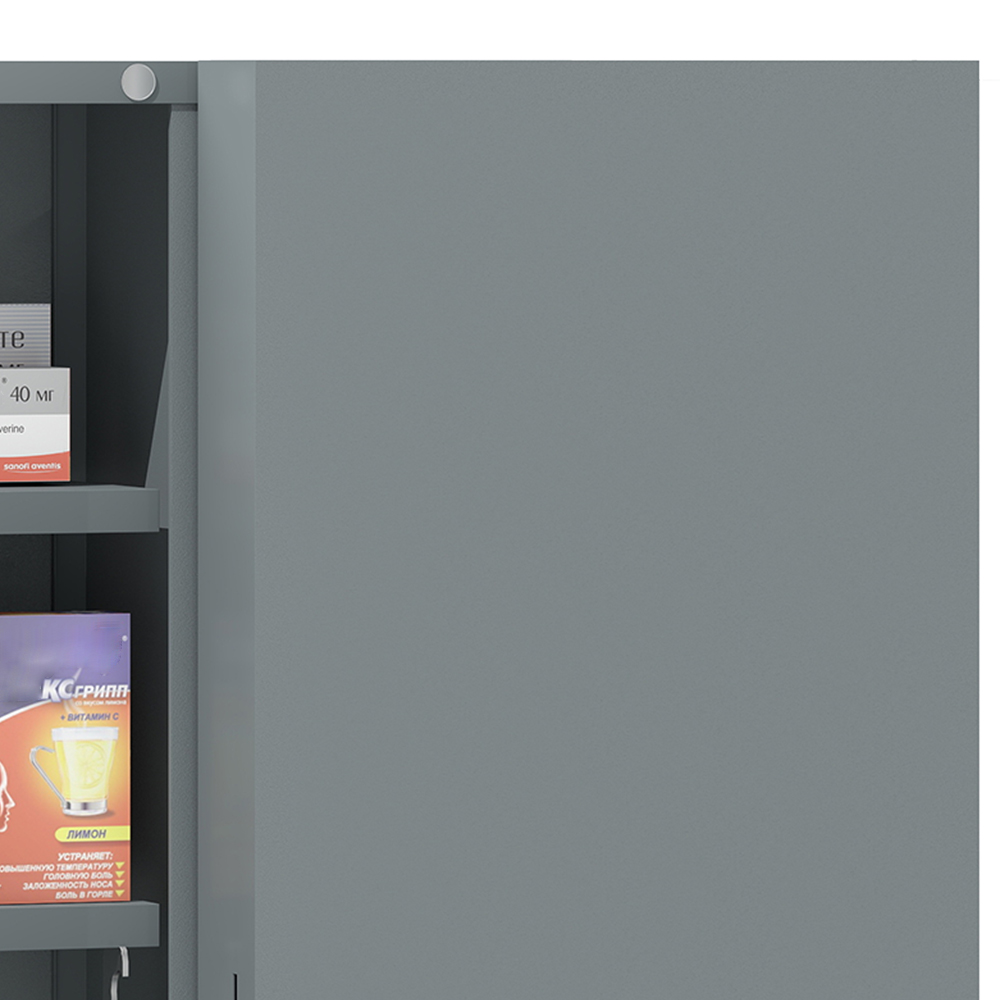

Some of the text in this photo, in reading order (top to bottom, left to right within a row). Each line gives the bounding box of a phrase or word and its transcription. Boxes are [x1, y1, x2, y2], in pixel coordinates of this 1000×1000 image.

[9, 386, 55, 402] 40 мг
[3, 462, 62, 471] sanofi aventis
[67, 712, 111, 721] ВИТАМИН
[66, 829, 107, 839] ЛИМОН
[57, 851, 113, 861] УСТРАНЯЕТ:
